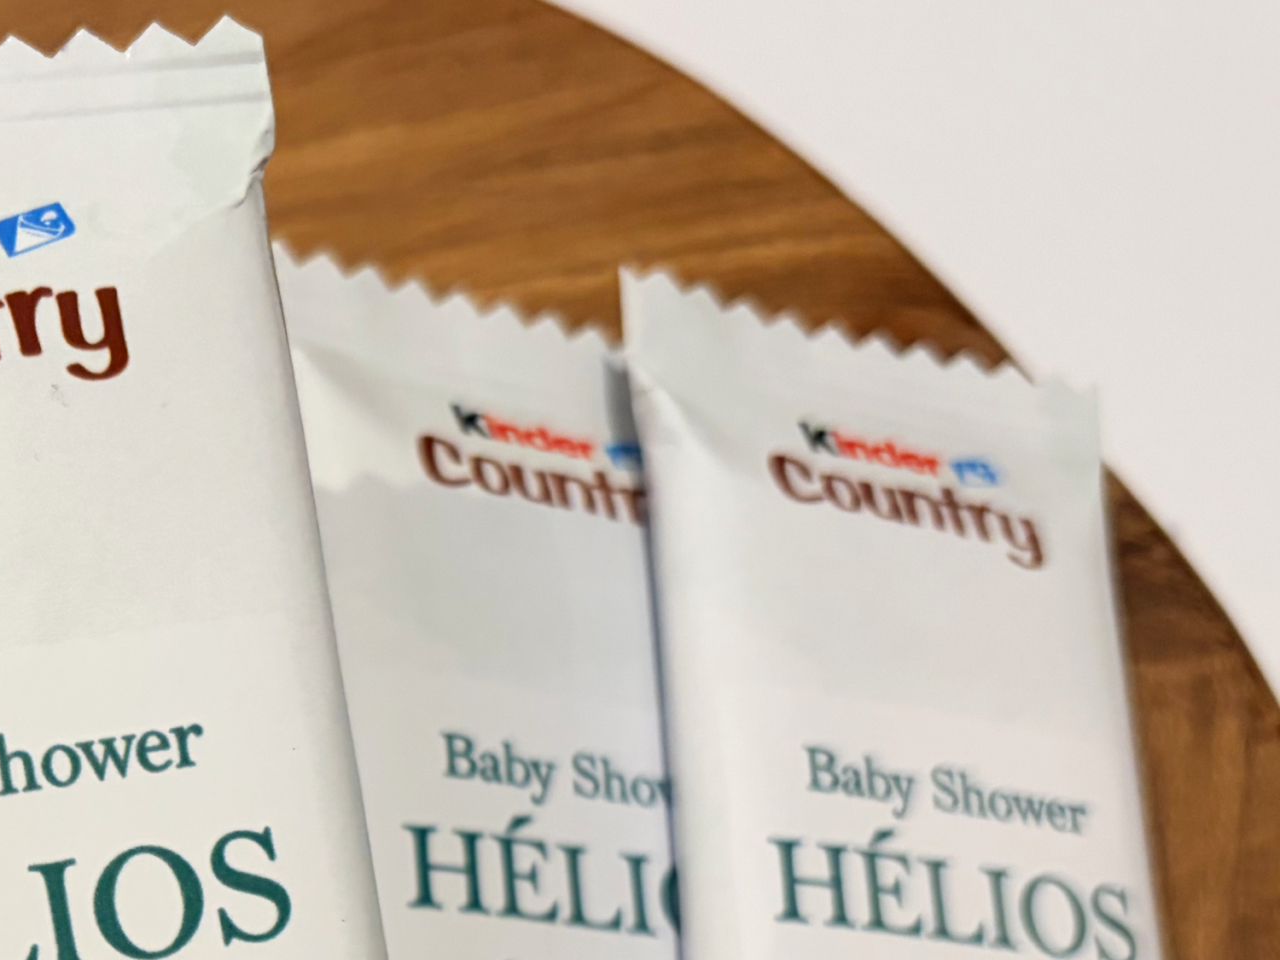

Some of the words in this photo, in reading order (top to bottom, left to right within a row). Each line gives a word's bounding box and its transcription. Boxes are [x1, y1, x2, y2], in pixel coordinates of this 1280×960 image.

[449, 402, 594, 459] Kinder
[798, 419, 941, 476] Kinder
[768, 454, 1046, 571] Country
[441, 731, 555, 805] Baby
[804, 745, 915, 819] Baby
[930, 764, 1087, 834] Shower
